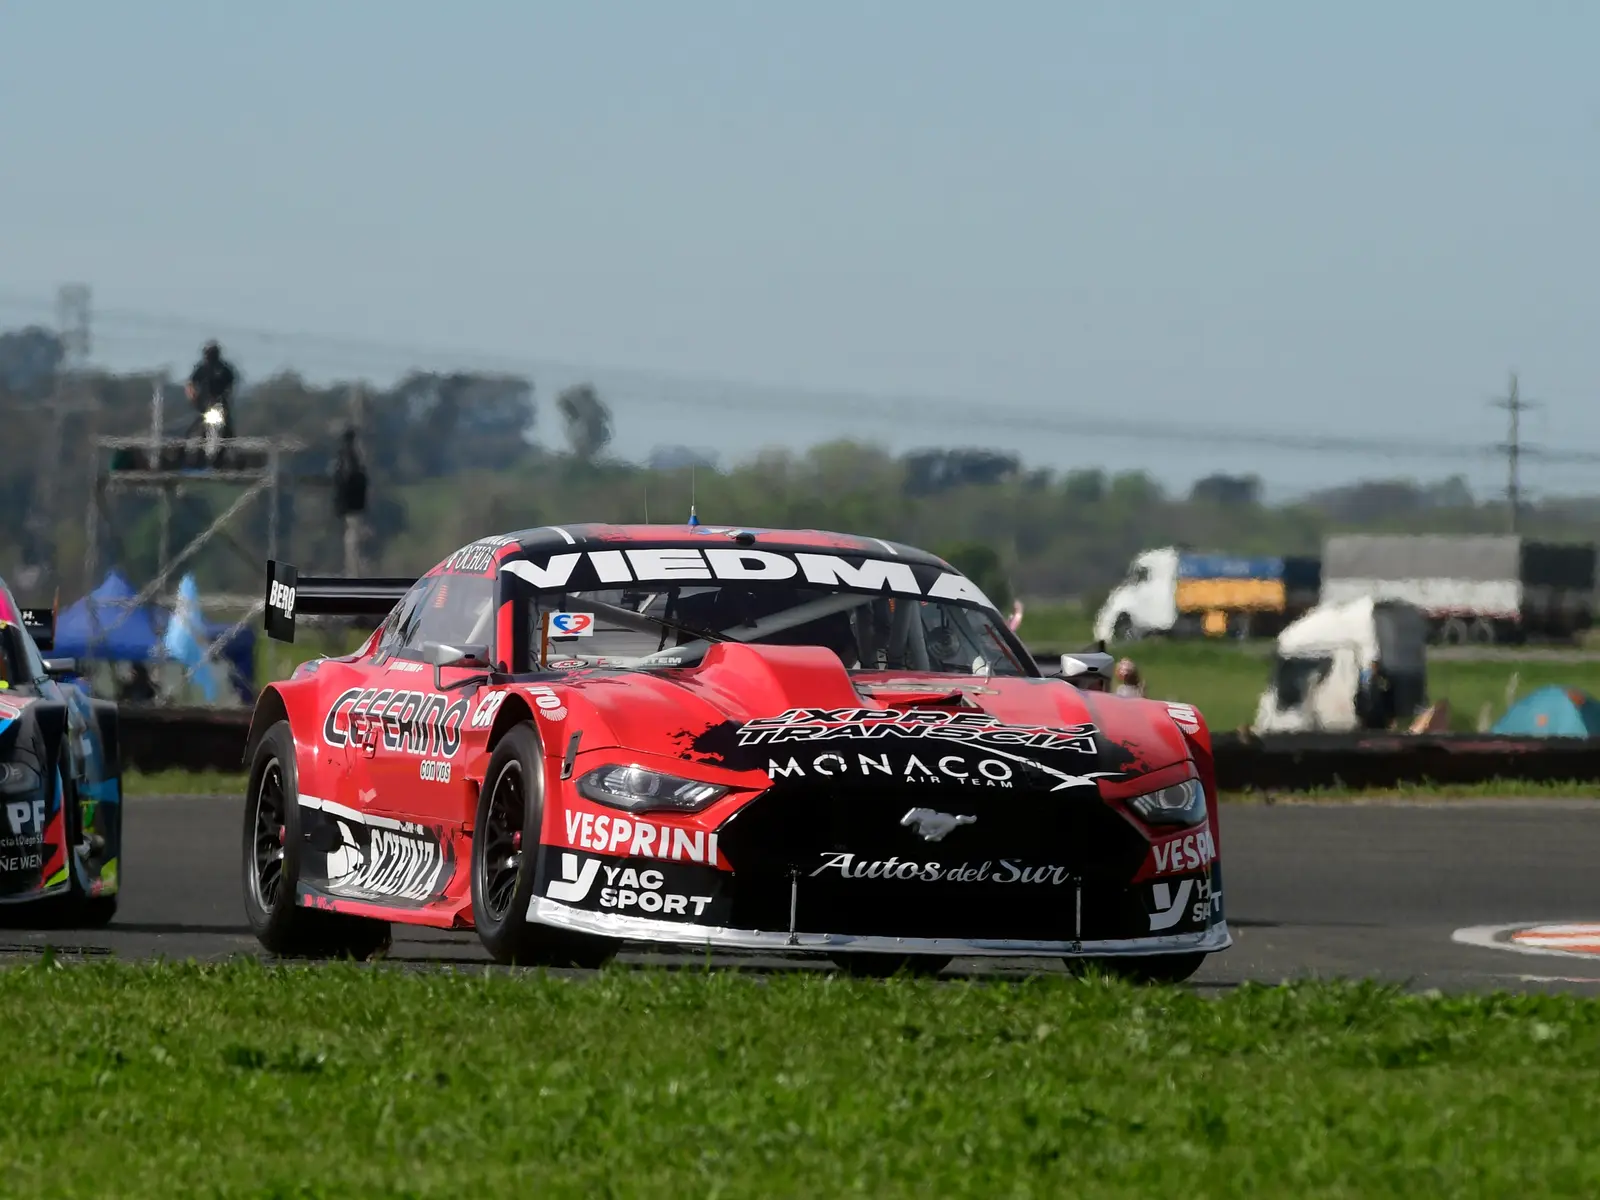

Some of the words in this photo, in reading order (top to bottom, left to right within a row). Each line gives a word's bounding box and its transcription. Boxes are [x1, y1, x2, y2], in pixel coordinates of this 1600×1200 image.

[499, 549, 1004, 618] VIEDMA
[323, 687, 470, 758] CEFERINO
[736, 723, 1098, 754] TRANSCIA
[768, 753, 1013, 780] MONACO
[906, 776, 941, 784] AIR
[957, 777, 1013, 788] TEAM
[565, 809, 719, 866] VESPRINI
[350, 828, 444, 900] SCIENZA
[603, 865, 664, 890] YAC
[809, 852, 946, 882] Autos
[946, 860, 993, 882] del
[992, 858, 1069, 885] Sur
[600, 887, 713, 916] SPORT
